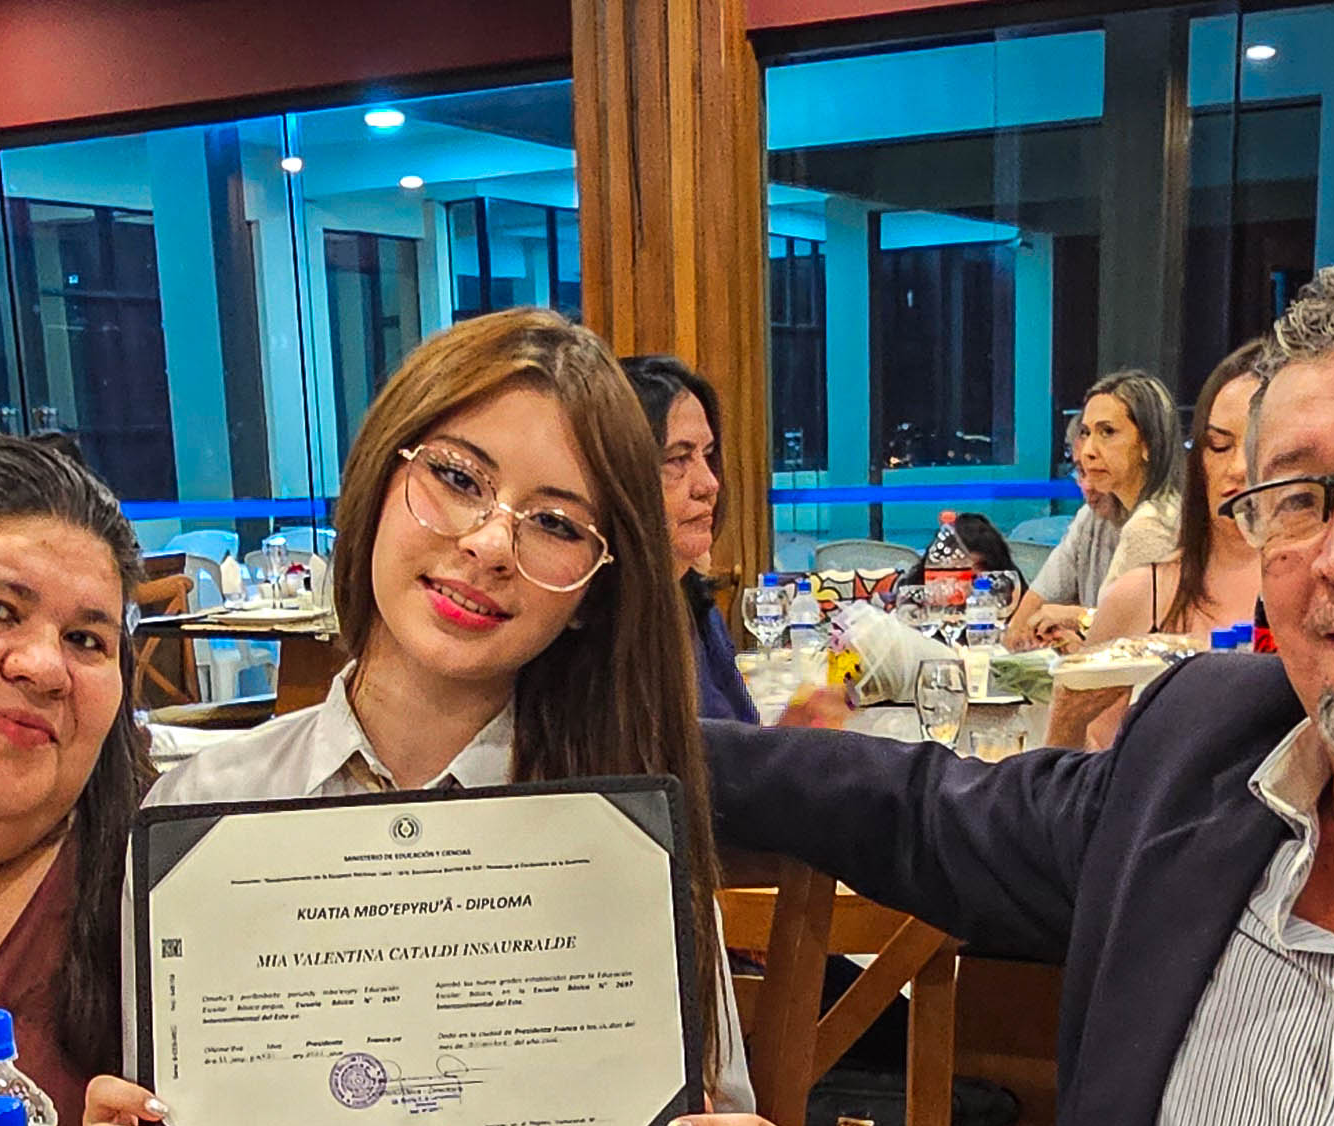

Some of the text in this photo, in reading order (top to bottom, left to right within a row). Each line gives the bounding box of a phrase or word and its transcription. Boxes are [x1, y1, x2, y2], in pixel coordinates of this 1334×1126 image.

[344, 855, 381, 863] MINISTERIO
[383, 854, 393, 862] DE
[395, 851, 434, 861] EDUCACIÓN
[442, 849, 472, 858] CIENCIAS
[297, 906, 350, 921] KUATIA
[466, 895, 532, 911] DIPLOMA
[257, 935, 577, 968] MIA VALENTINA CATALDI INSAURRALDE
